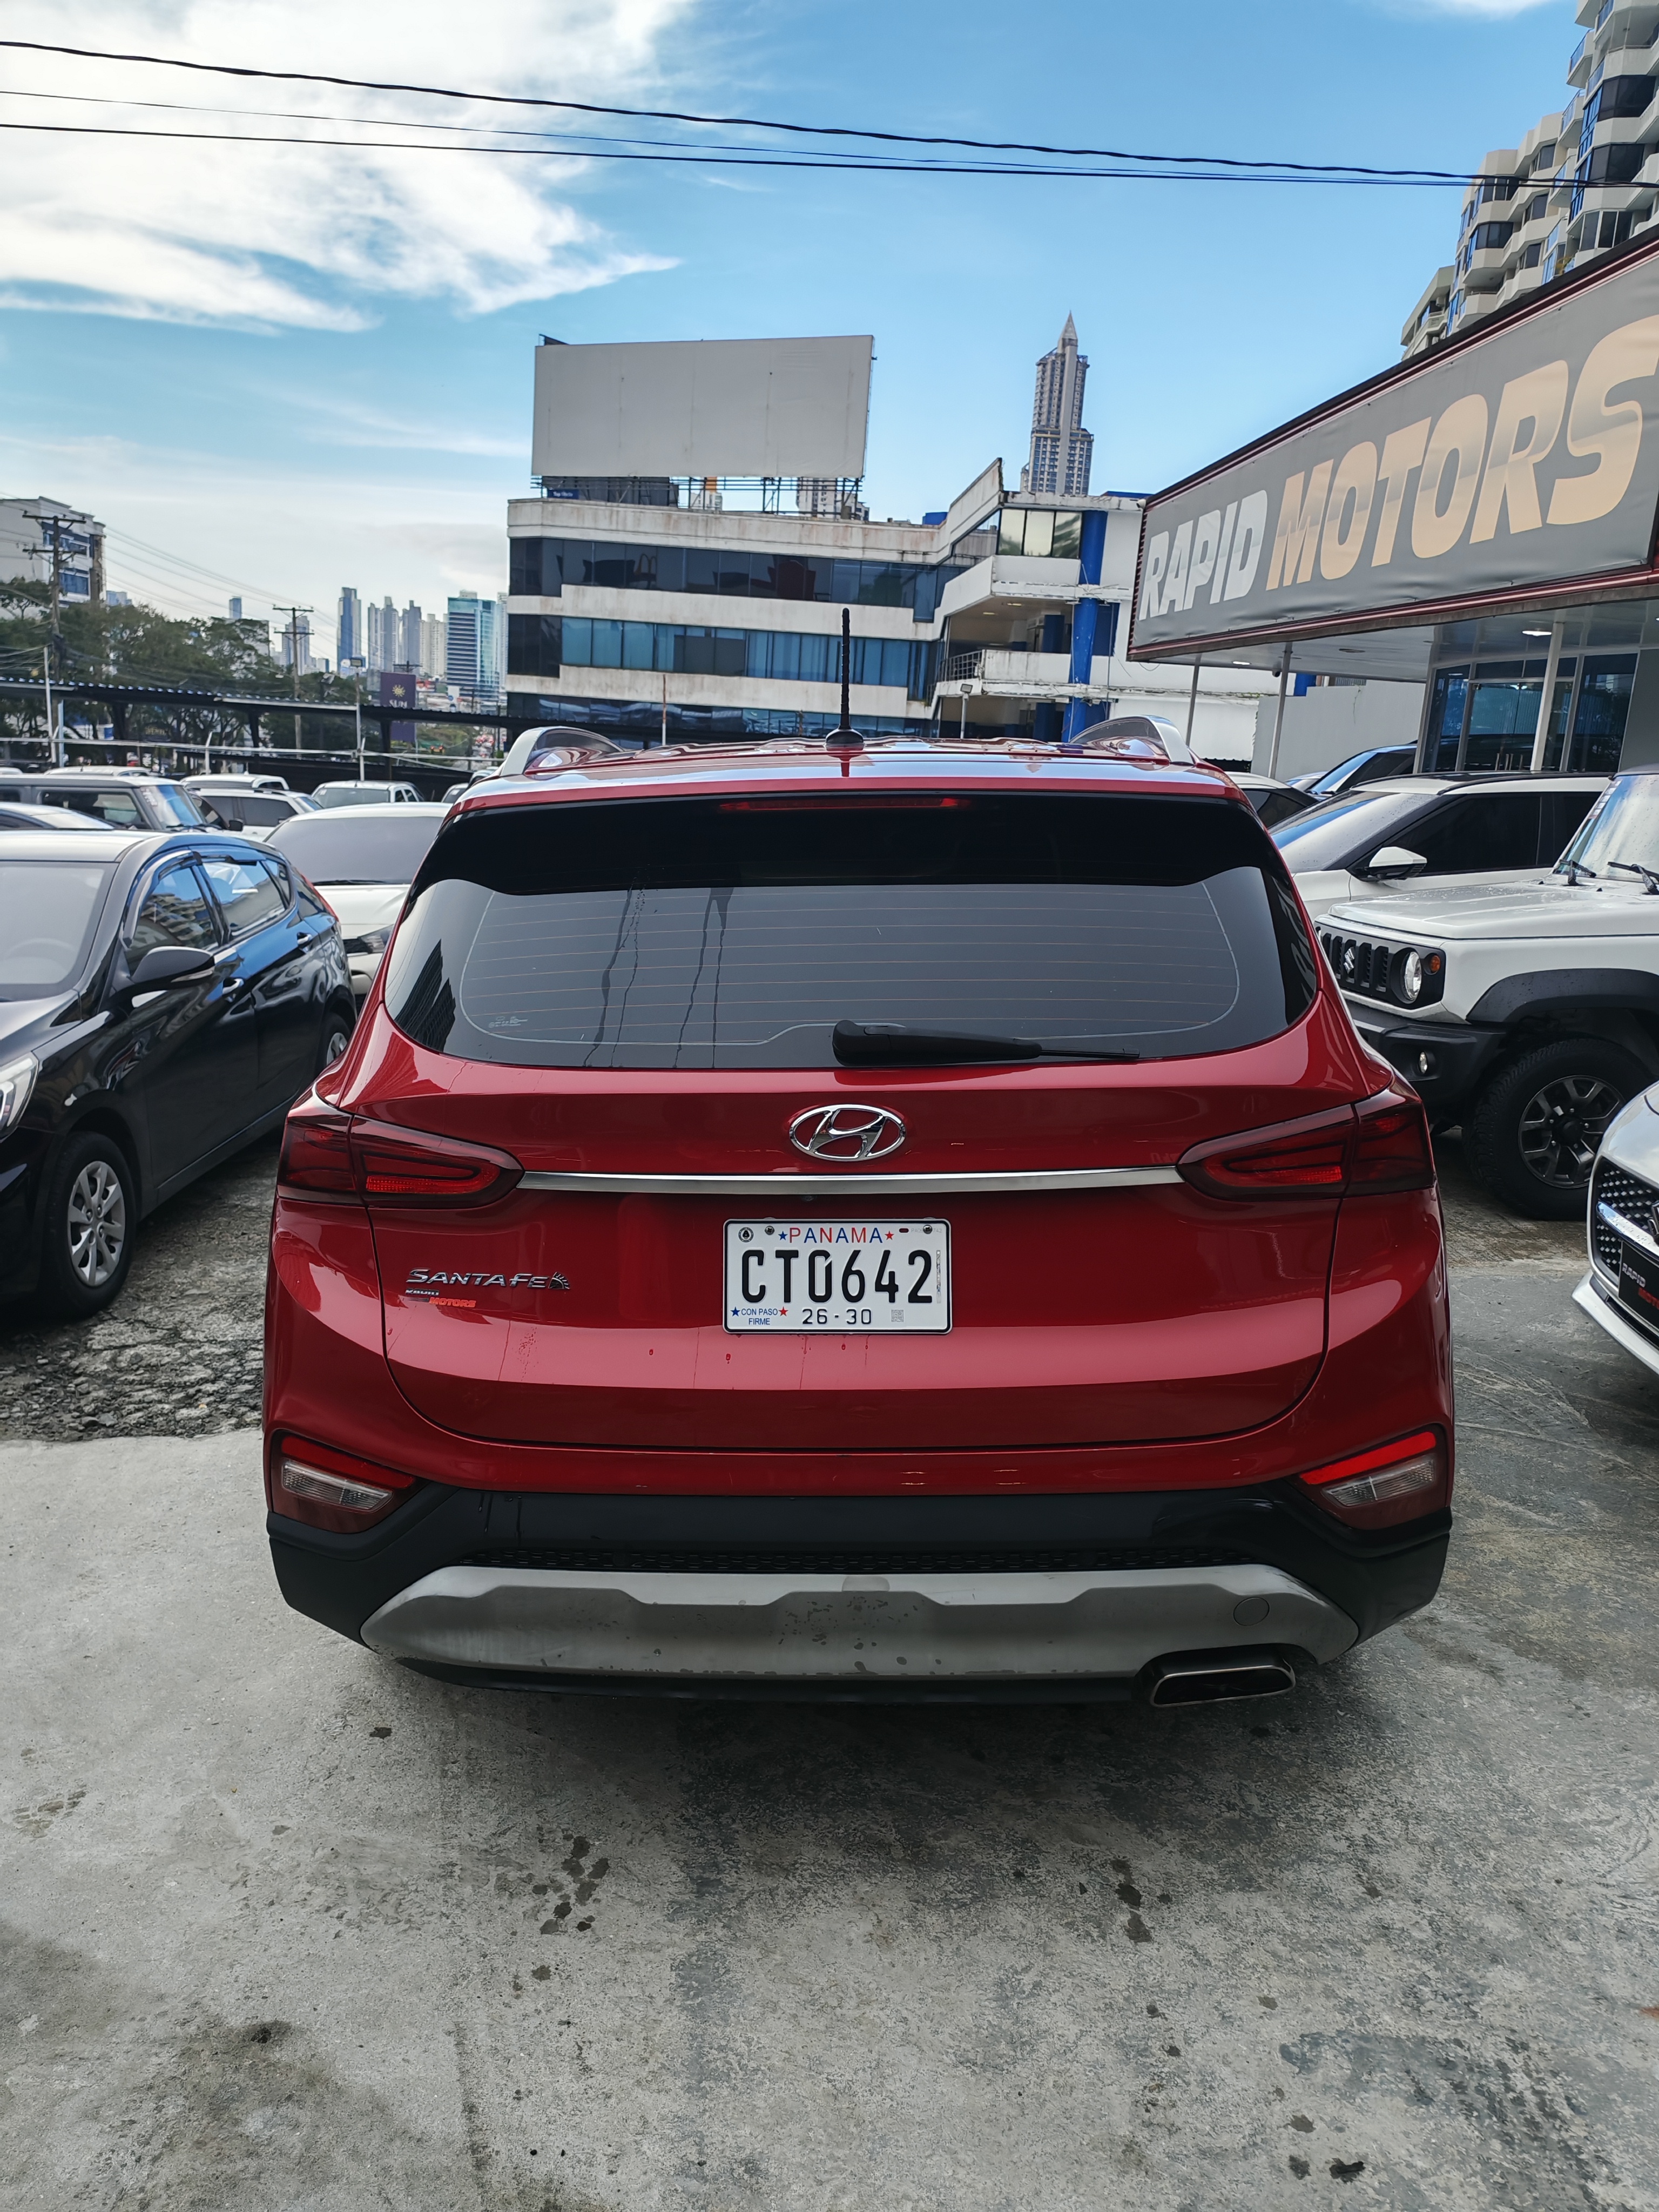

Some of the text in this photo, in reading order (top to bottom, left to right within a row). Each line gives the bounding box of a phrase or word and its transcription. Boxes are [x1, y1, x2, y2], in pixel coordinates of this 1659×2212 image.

[1138, 314, 1659, 621] RAPID MOTORS
[389, 699, 407, 709] SUN
[789, 1227, 883, 1244] PANAMA
[741, 1249, 932, 1304] CT0642
[429, 1297, 476, 1307] MOTORS
[741, 1308, 778, 1316] CON PASO
